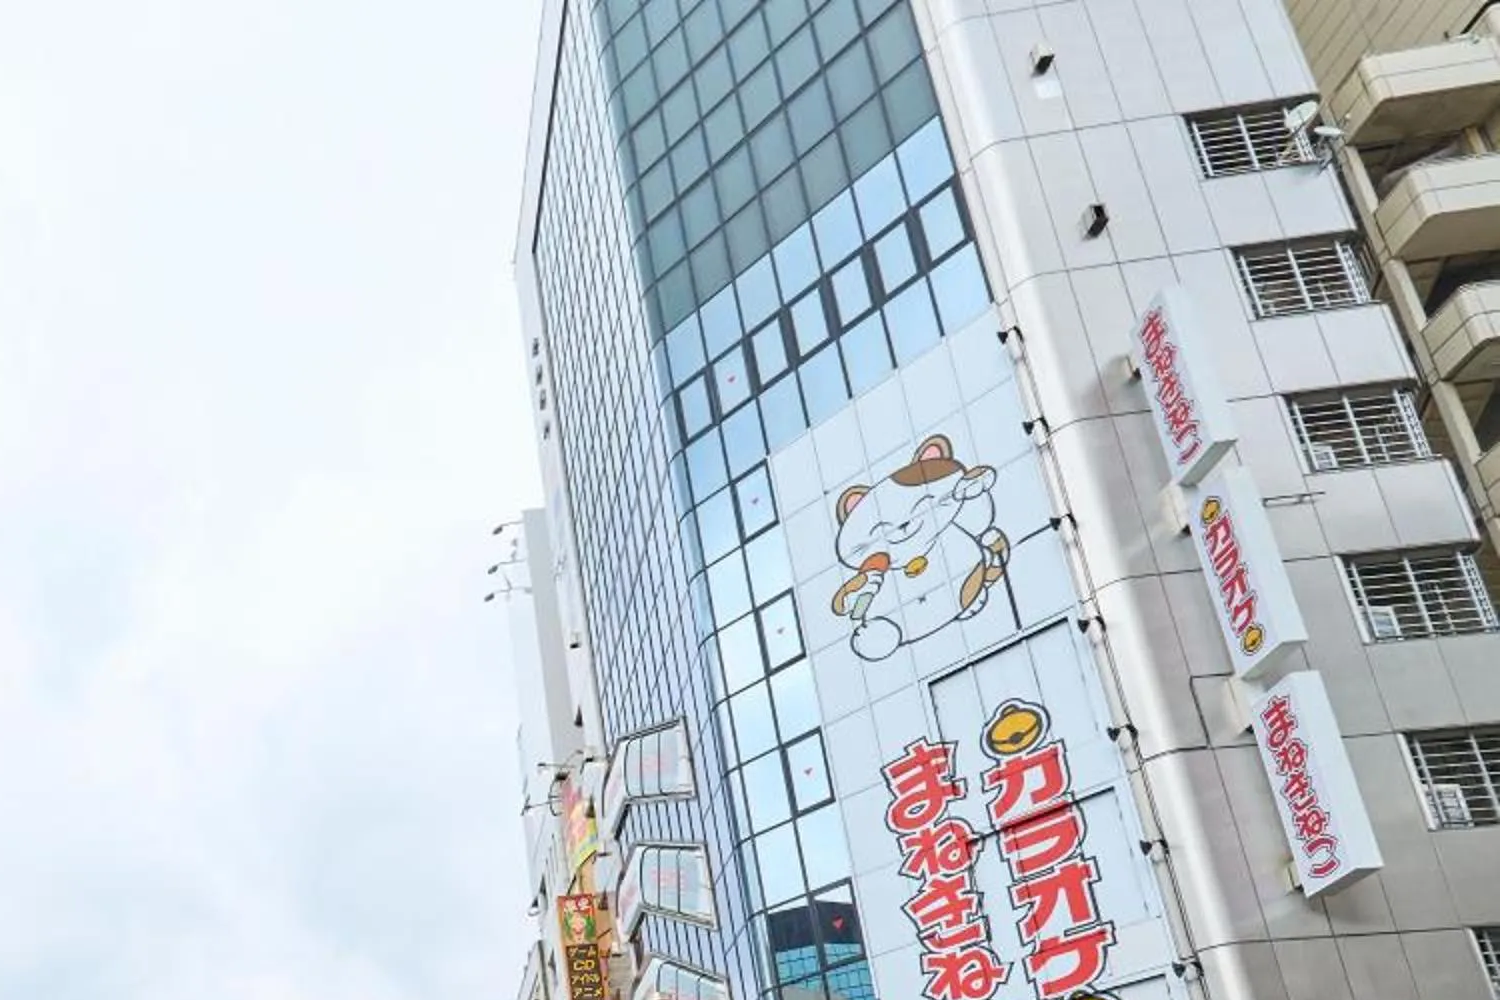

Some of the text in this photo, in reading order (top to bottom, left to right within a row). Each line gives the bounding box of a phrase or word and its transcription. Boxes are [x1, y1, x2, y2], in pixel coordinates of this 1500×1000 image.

[1140, 305, 1201, 465] まねきねこ
[1204, 512, 1258, 633] カラオケ
[1260, 695, 1342, 880] まねきねこ
[983, 742, 1114, 1000] カラオケ
[574, 988, 603, 998] アニメ
